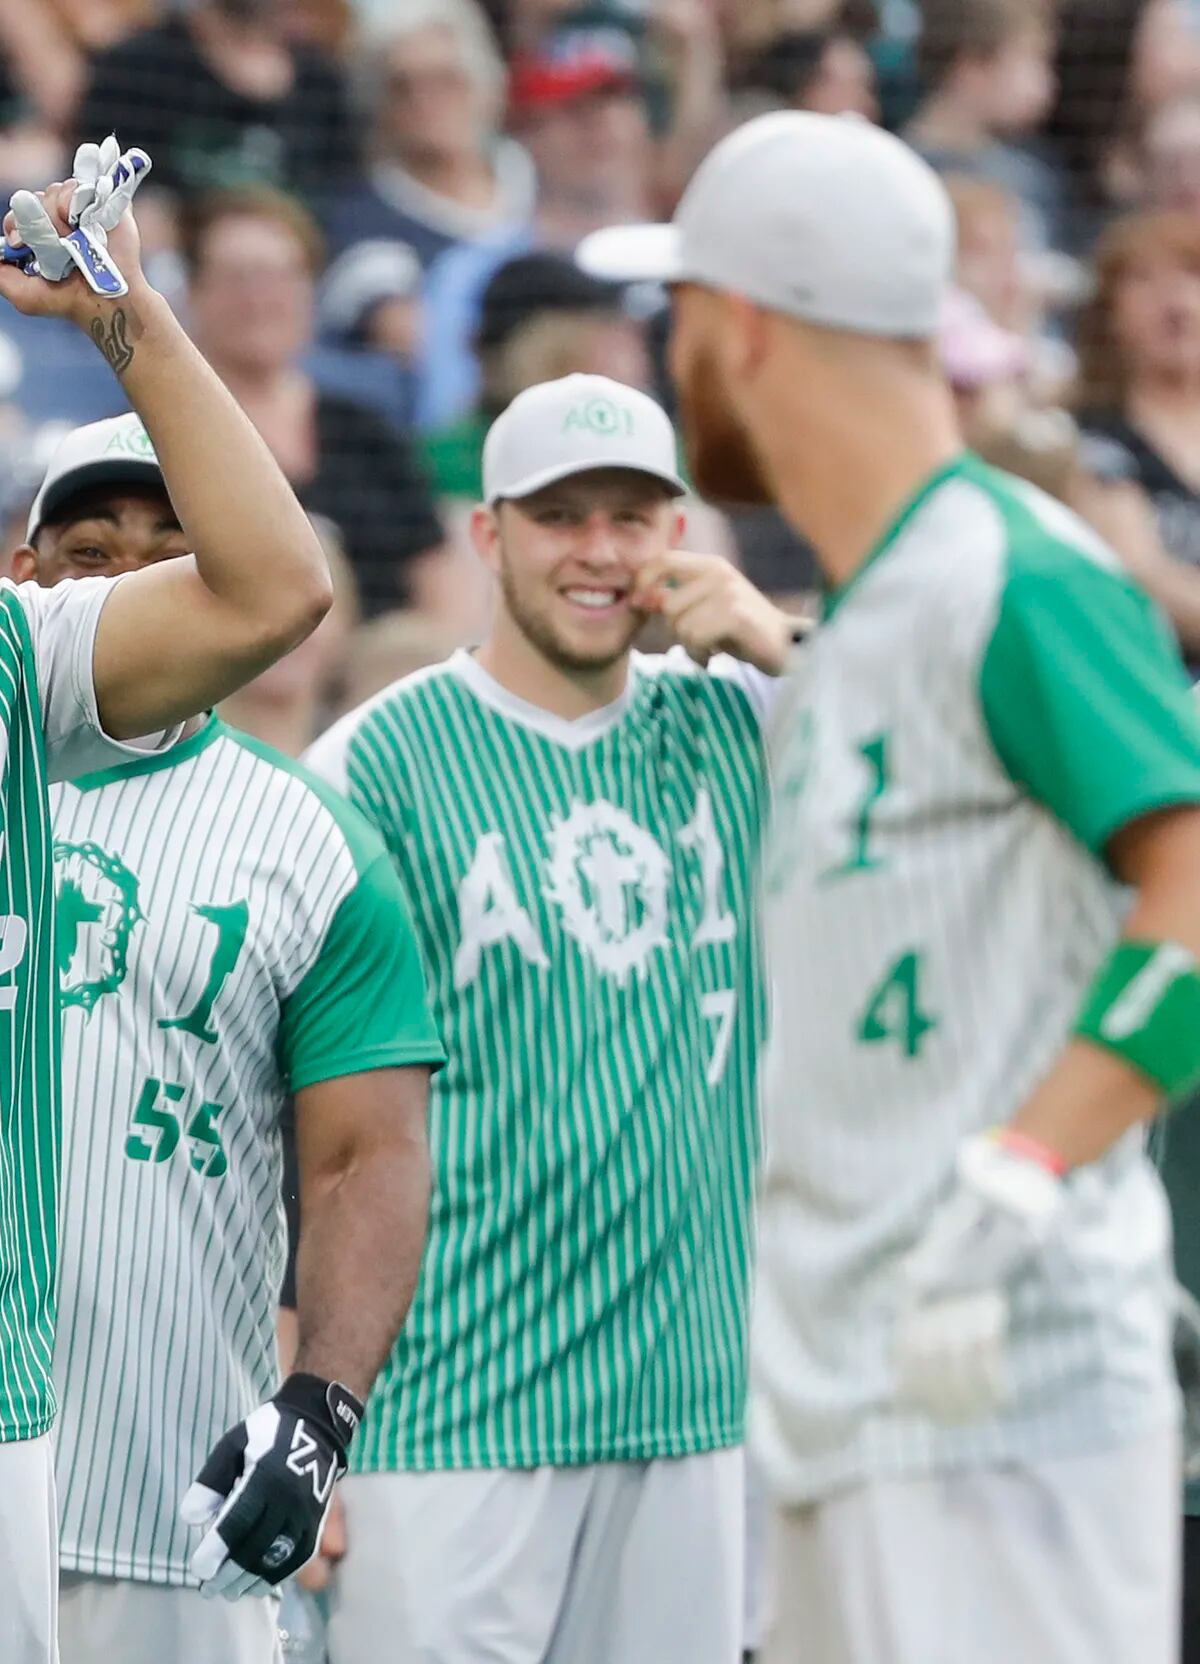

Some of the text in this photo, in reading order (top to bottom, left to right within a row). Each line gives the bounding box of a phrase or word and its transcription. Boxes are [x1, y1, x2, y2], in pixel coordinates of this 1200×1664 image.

[701, 988, 737, 1085] 7
[855, 950, 937, 1058] 4
[124, 1077, 228, 1178] 55
